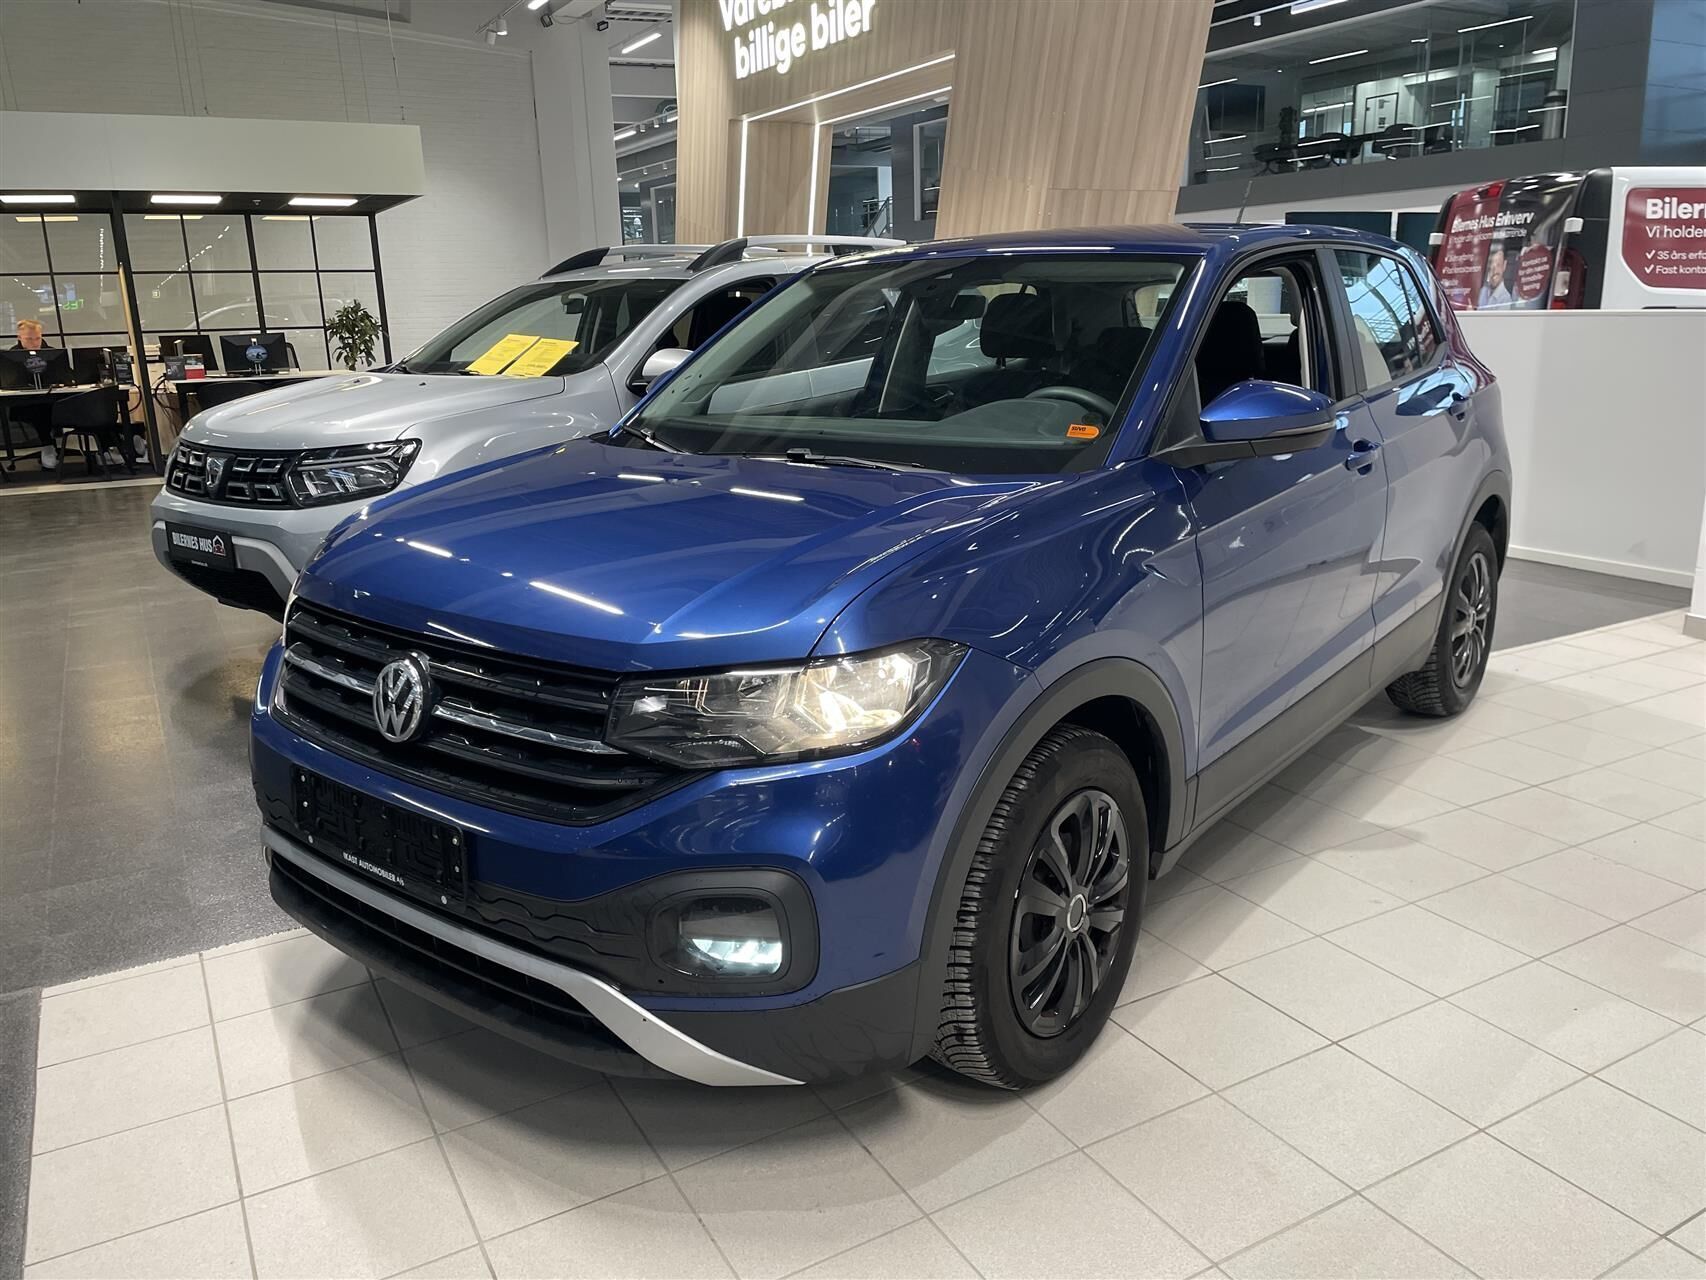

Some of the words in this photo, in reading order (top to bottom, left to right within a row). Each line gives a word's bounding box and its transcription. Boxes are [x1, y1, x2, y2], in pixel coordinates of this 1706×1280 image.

[734, 21, 806, 79] billige
[810, 0, 875, 50] biler
[1645, 197, 1706, 219] Biler
[1479, 214, 1495, 229] Hus
[1645, 225, 1660, 238] Vi
[1670, 249, 1687, 260] års
[1656, 264, 1678, 274] Fast
[199, 537, 213, 553] HUS
[359, 859, 397, 883] AUTOMOBILER
